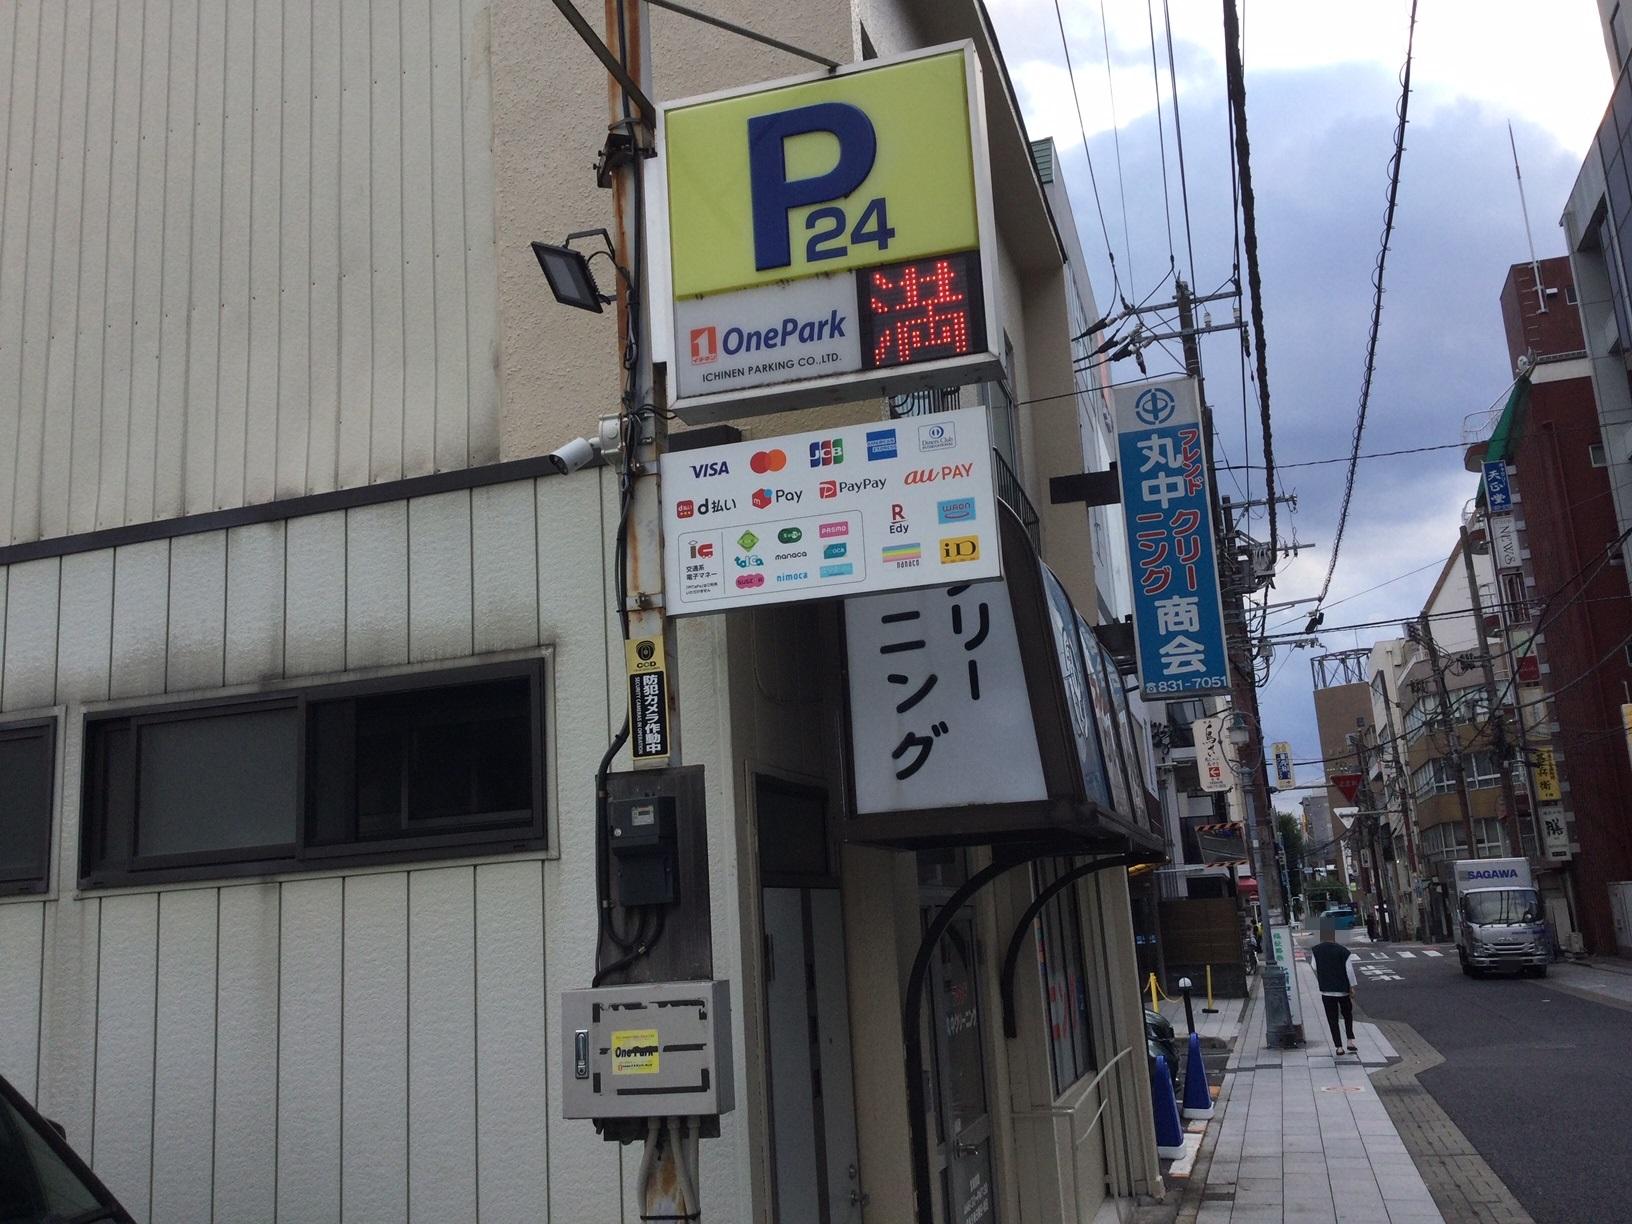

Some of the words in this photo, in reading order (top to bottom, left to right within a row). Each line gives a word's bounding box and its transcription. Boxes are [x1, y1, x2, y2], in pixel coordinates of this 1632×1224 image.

[747, 102, 877, 272] P
[805, 197, 896, 263] 24
[722, 309, 847, 356] OnePark
[702, 367, 746, 383] ICHINEN
[748, 359, 795, 375] PARKING
[688, 460, 730, 479] VISA
[1136, 433, 1186, 509] 丸中
[1177, 427, 1204, 497] フレンド
[903, 468, 941, 486] au
[941, 462, 974, 481] PAY
[839, 477, 887, 494] PayPay
[775, 488, 803, 505] Pay
[697, 498, 737, 515] d払い
[821, 525, 847, 534] PASMO
[889, 523, 909, 535] Edy
[775, 551, 808, 561] manaca
[943, 540, 977, 558] iD
[1136, 511, 1172, 596] ニング
[1169, 509, 1201, 591] クリー
[897, 559, 920, 569] nanaco
[776, 572, 809, 582] nimoca
[1154, 595, 1207, 675] 商会
[636, 660, 657, 669] CCD
[642, 674, 662, 754] 防犯カメラ作動中
[1467, 868, 1519, 880] SAGAWA
